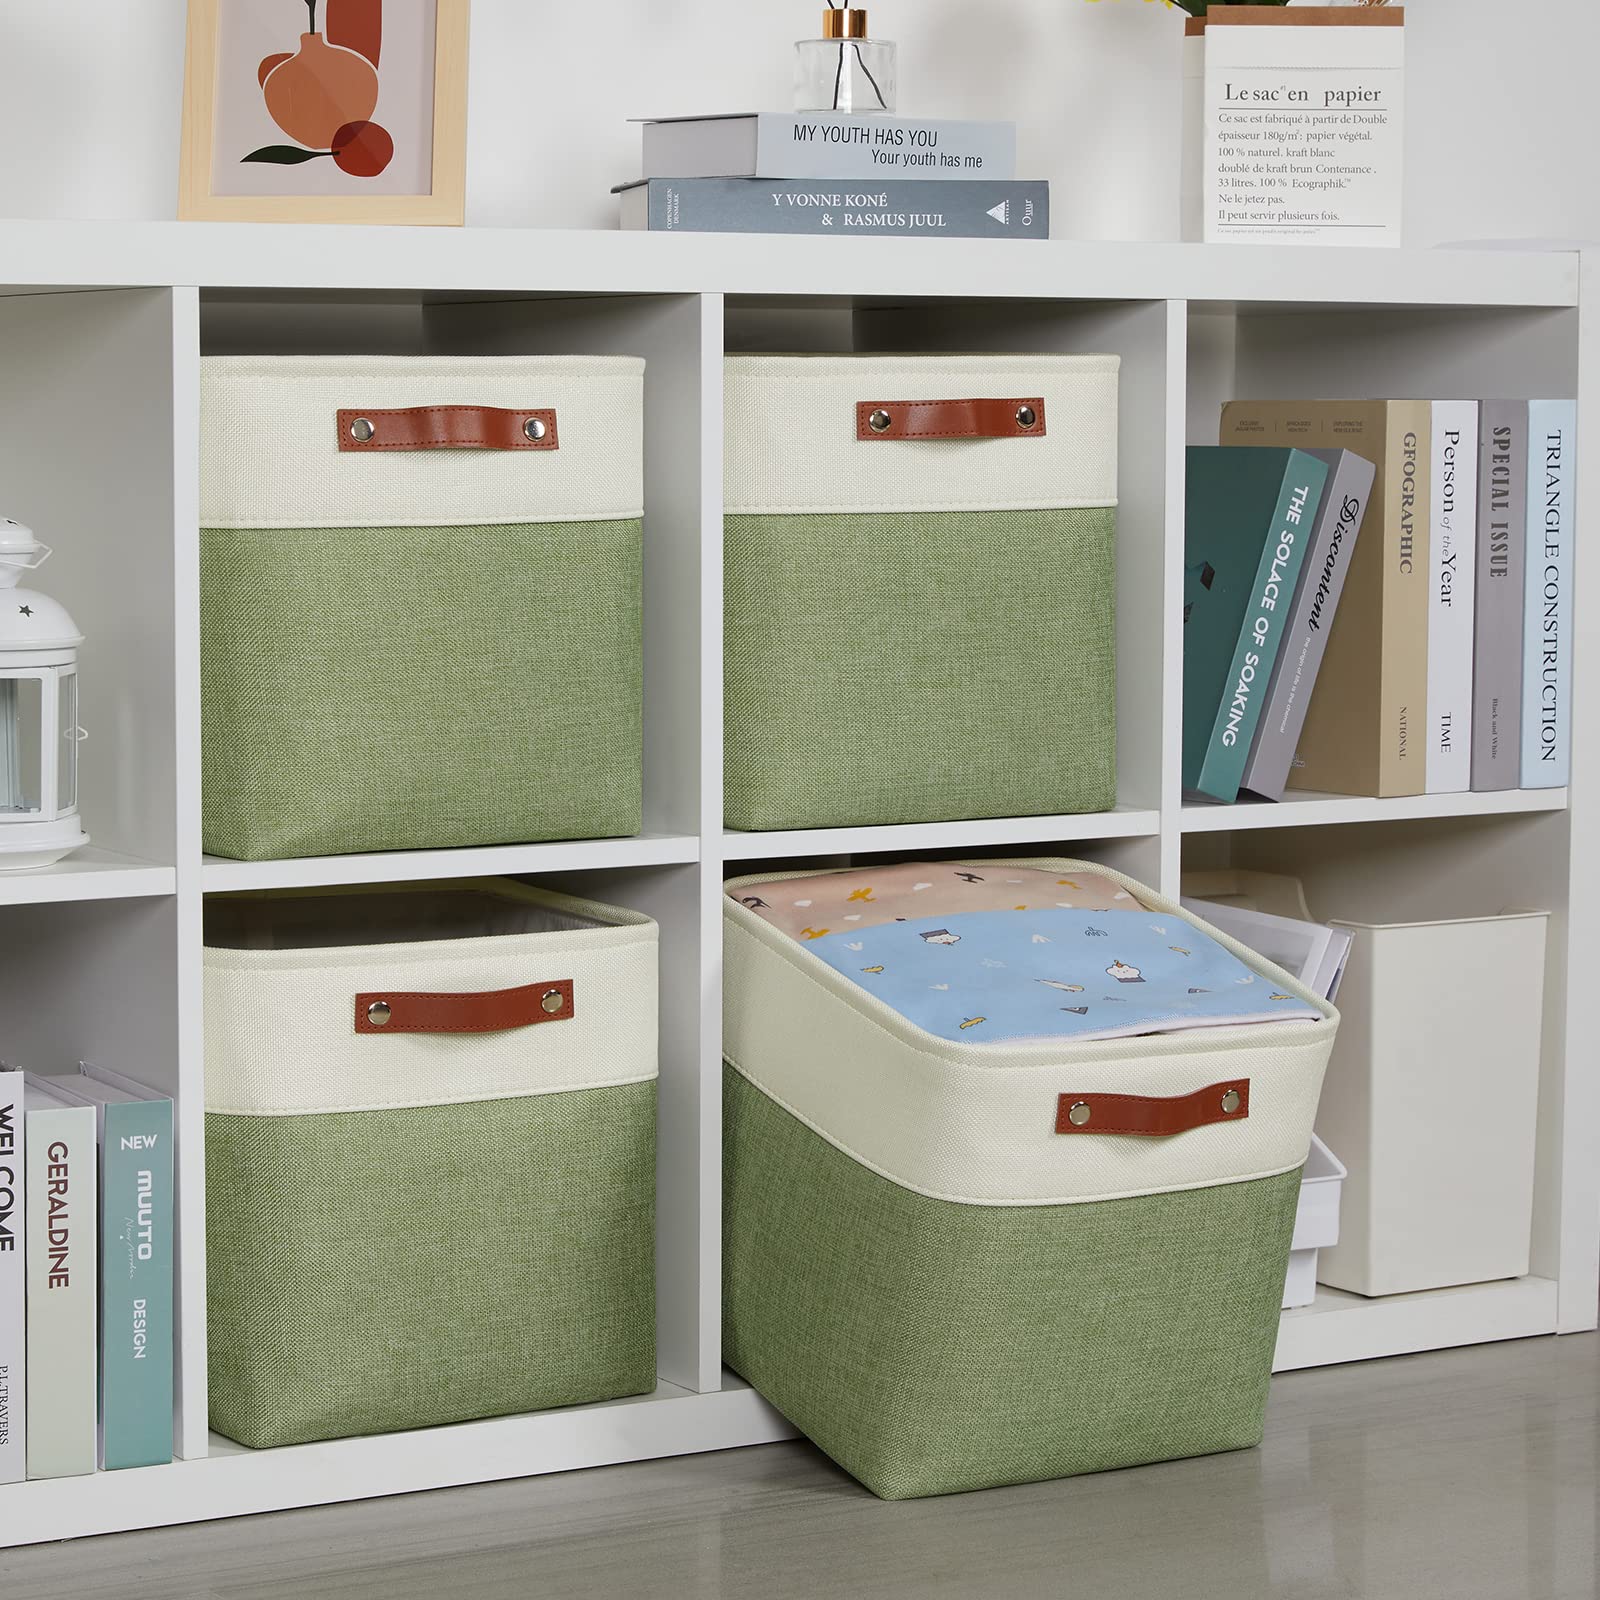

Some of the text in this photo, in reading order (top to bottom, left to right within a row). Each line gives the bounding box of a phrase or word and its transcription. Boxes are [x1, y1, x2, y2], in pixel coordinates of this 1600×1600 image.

[1226, 84, 1248, 100] Le
[1288, 91, 1308, 101] en
[1325, 86, 1381, 107] papier
[1219, 114, 1231, 122] Ce
[1265, 113, 1302, 126] fabriqué
[1313, 115, 1338, 126] partir
[1340, 114, 1351, 123] de
[1354, 114, 1387, 124] Double
[794, 125, 937, 147] MY YOUTH HAS YOU
[1218, 131, 1260, 142] épaisseur
[1307, 131, 1336, 142] papier
[1339, 131, 1372, 143] végétal.
[872, 149, 982, 168] Your youth has me
[1219, 148, 1234, 156] 100
[1236, 148, 1245, 156] %
[1286, 148, 1307, 157] kraft
[1310, 148, 1335, 157] blanc
[1218, 163, 1249, 173] doublé
[1253, 164, 1264, 173] de
[1267, 164, 1287, 174] kraft
[1290, 164, 1312, 173] brun
[1218, 178, 1229, 187] 33
[1232, 178, 1256, 187] litres.
[1261, 178, 1276, 186] 100
[1278, 178, 1287, 187] %
[772, 193, 887, 207] Y VONNE KONÉ
[1219, 194, 1285, 206] Ne le jetez pas.
[822, 214, 946, 228] & RASMUS JUUL
[1219, 210, 1339, 222] Il peut servir plusieurs fois.
[1400, 432, 1416, 573] GFOGRAPHIC
[1490, 427, 1511, 577] SPECIAL ISSUE
[1440, 431, 1459, 607] Person of the Year
[1307, 495, 1361, 632] Discontent
[1542, 430, 1561, 760] TRIANGLE CONSTRUCTION
[1221, 486, 1310, 748] THE SOLACE OF SOAKING
[1303, 637, 1311, 647] the
[1298, 648, 1308, 666] origin
[1293, 675, 1301, 685] life
[1296, 667, 1302, 675] of
[1279, 704, 1292, 733] chemical
[1441, 712, 1451, 752] TIME
[121, 1134, 157, 1150] NEW
[48, 1142, 69, 1289] GERALDINE
[134, 1299, 146, 1358] DESIGN
